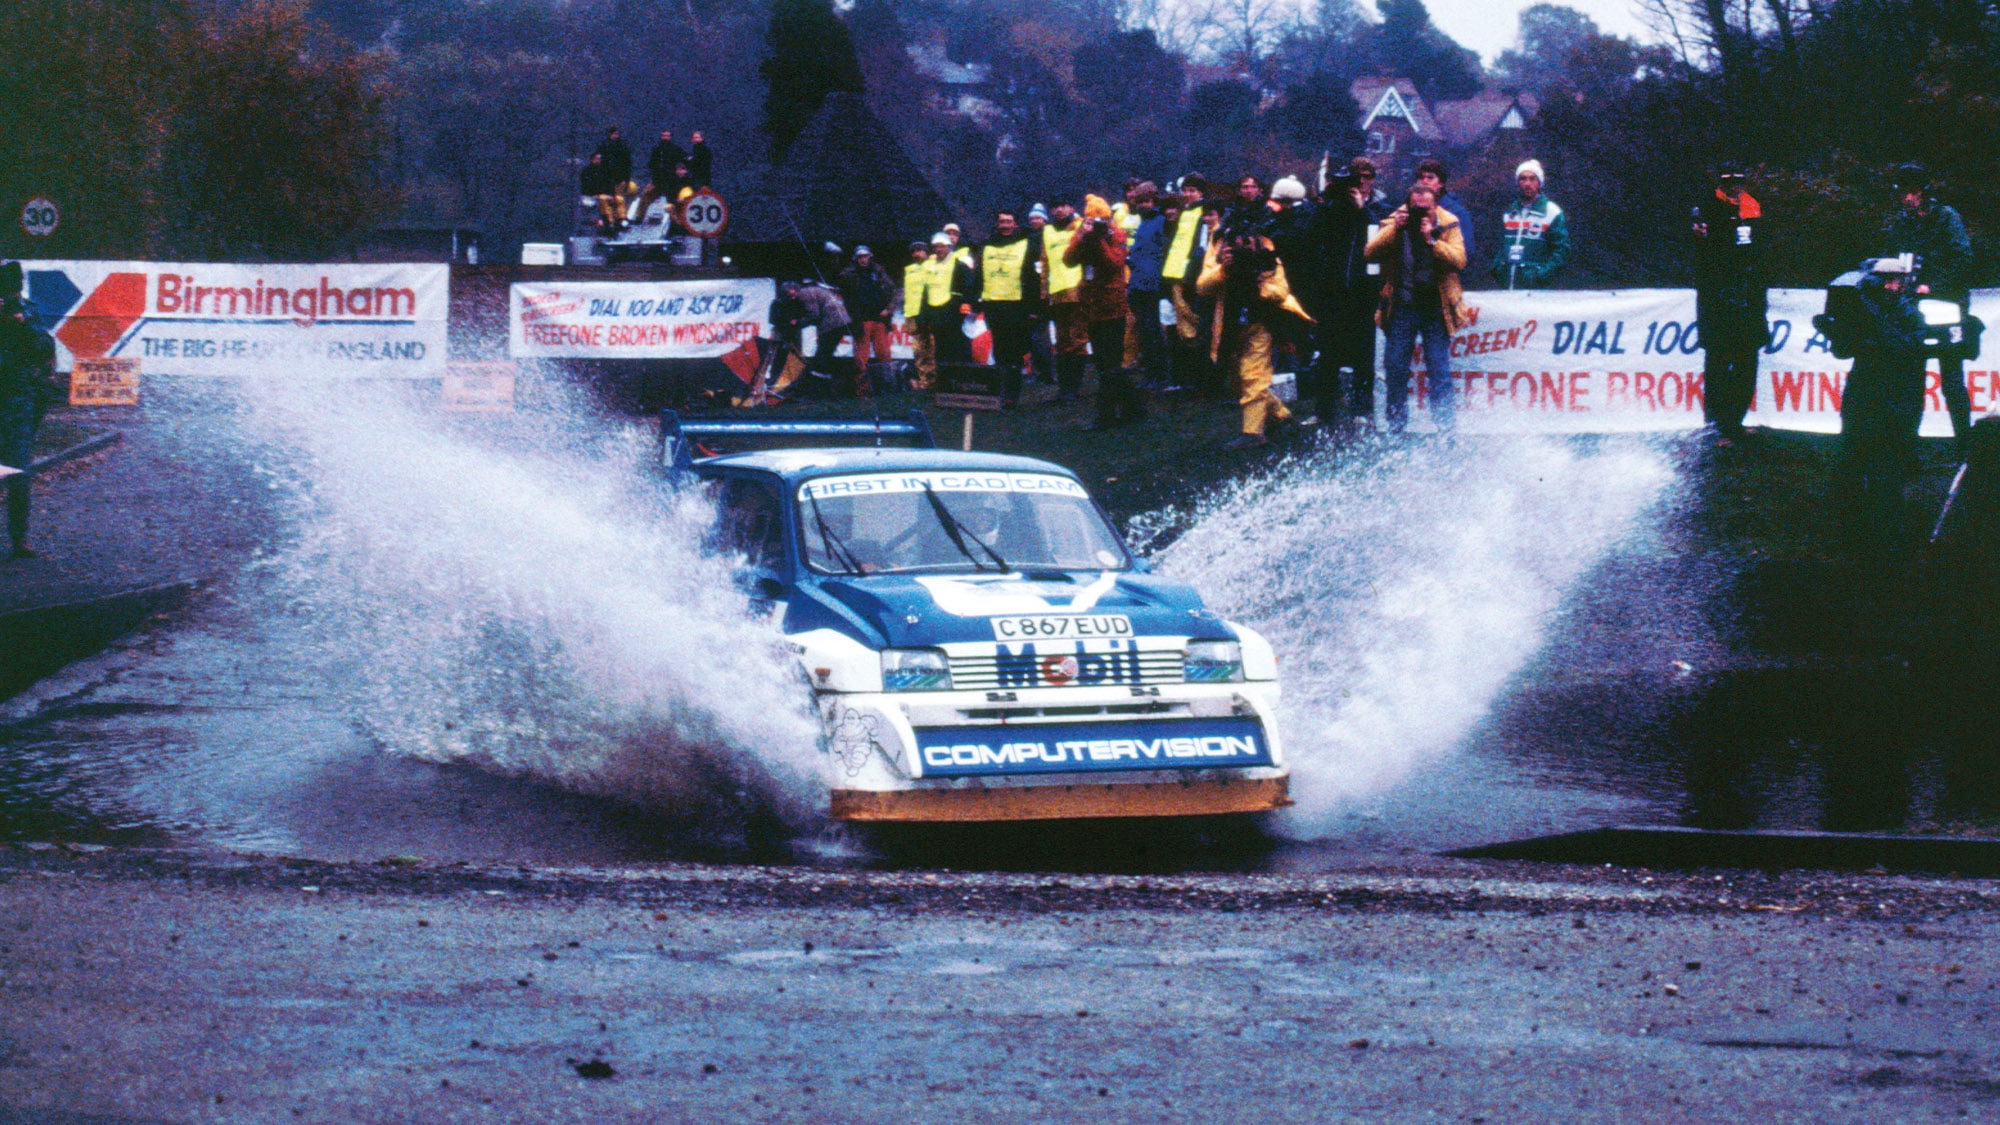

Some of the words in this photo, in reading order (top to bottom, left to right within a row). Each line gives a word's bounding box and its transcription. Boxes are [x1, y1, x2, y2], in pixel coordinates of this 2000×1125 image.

[25, 207, 55, 226] 30
[690, 204, 721, 223] 30
[156, 273, 416, 328] Birmingham
[589, 299, 621, 316] DIAL
[626, 299, 654, 316] 100
[654, 298, 684, 316] AND
[687, 295, 716, 315] ASK
[717, 295, 744, 314] FOR
[524, 323, 604, 347] FREEFONE
[607, 323, 669, 347] BROKEN
[672, 320, 760, 345] WINDSCREEN
[1552, 321, 1626, 355] DIAL
[1643, 321, 1700, 355] 100
[142, 337, 178, 358] THE
[183, 337, 217, 358] BIG
[802, 479, 892, 499] FIRST
[902, 476, 932, 489] IN
[941, 477, 1007, 490] CAD
[1016, 478, 1080, 493] CAM
[996, 639, 1142, 686] Mobil
[925, 736, 1257, 766] COMPUTERVISION
